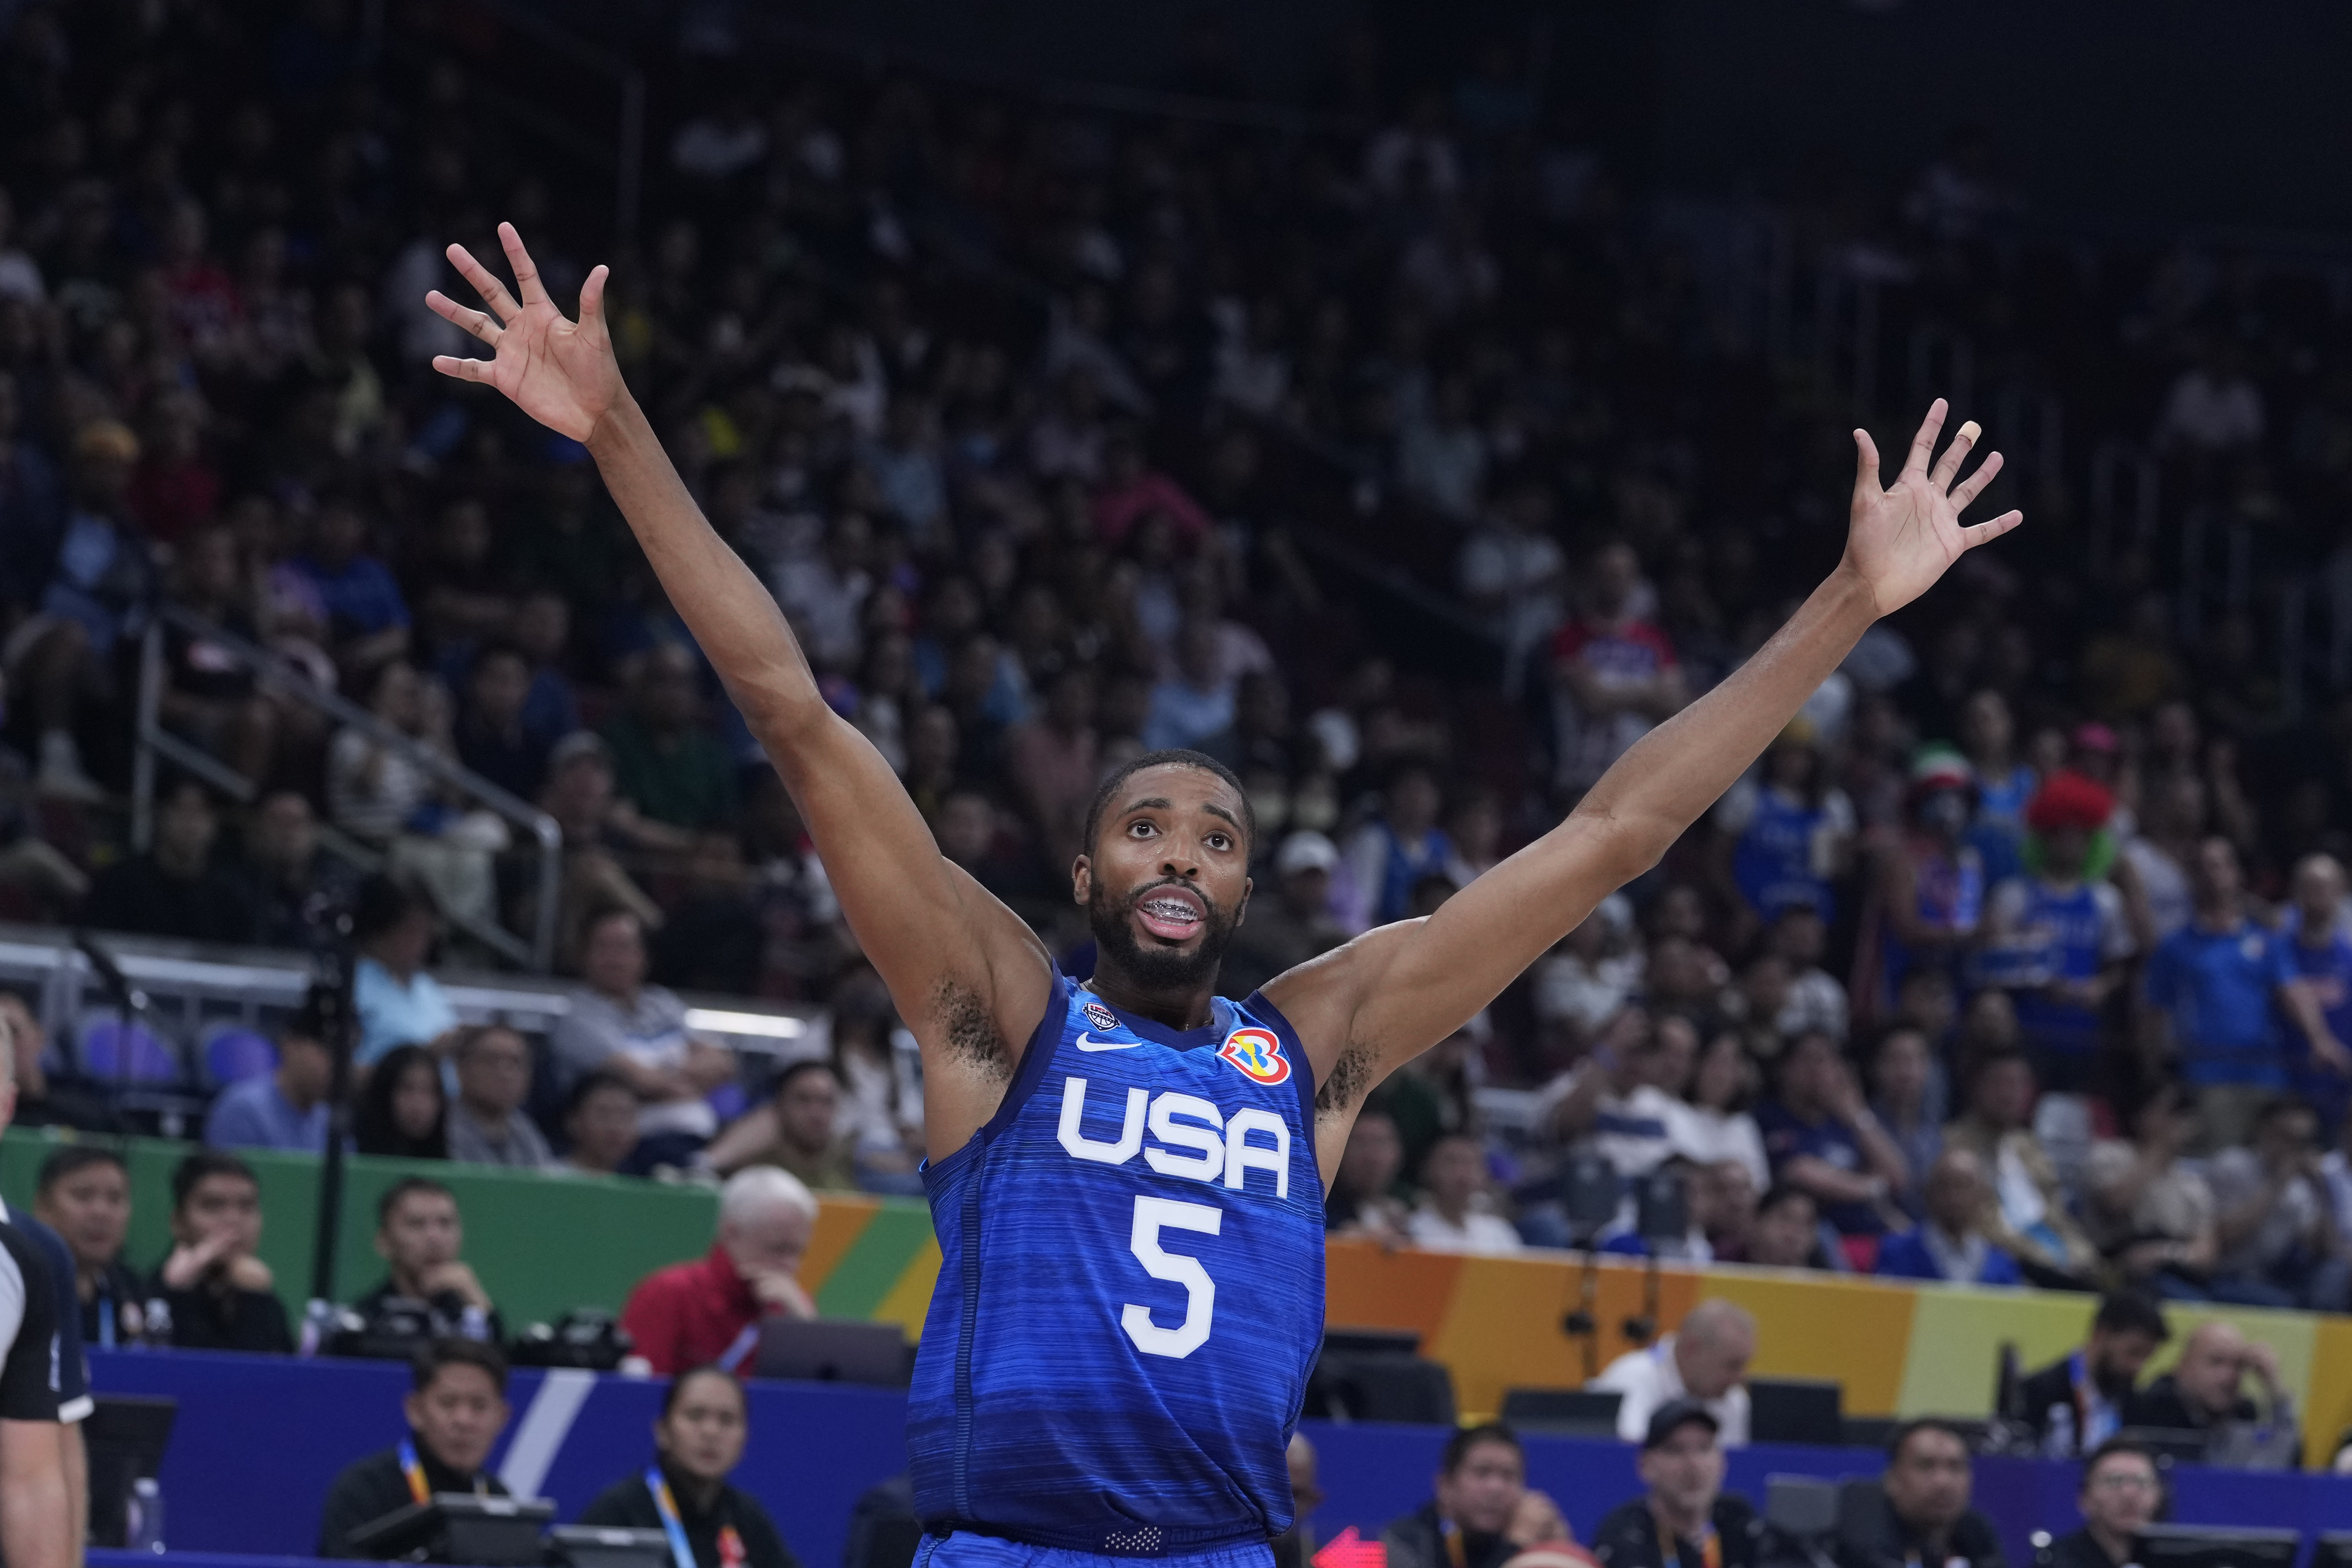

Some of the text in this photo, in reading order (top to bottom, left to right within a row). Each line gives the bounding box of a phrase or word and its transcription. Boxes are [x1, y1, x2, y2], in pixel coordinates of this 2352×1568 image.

[1090, 1005, 1113, 1020] USA
[1057, 1077, 1290, 1199] USA
[1121, 1195, 1223, 1359] 5
